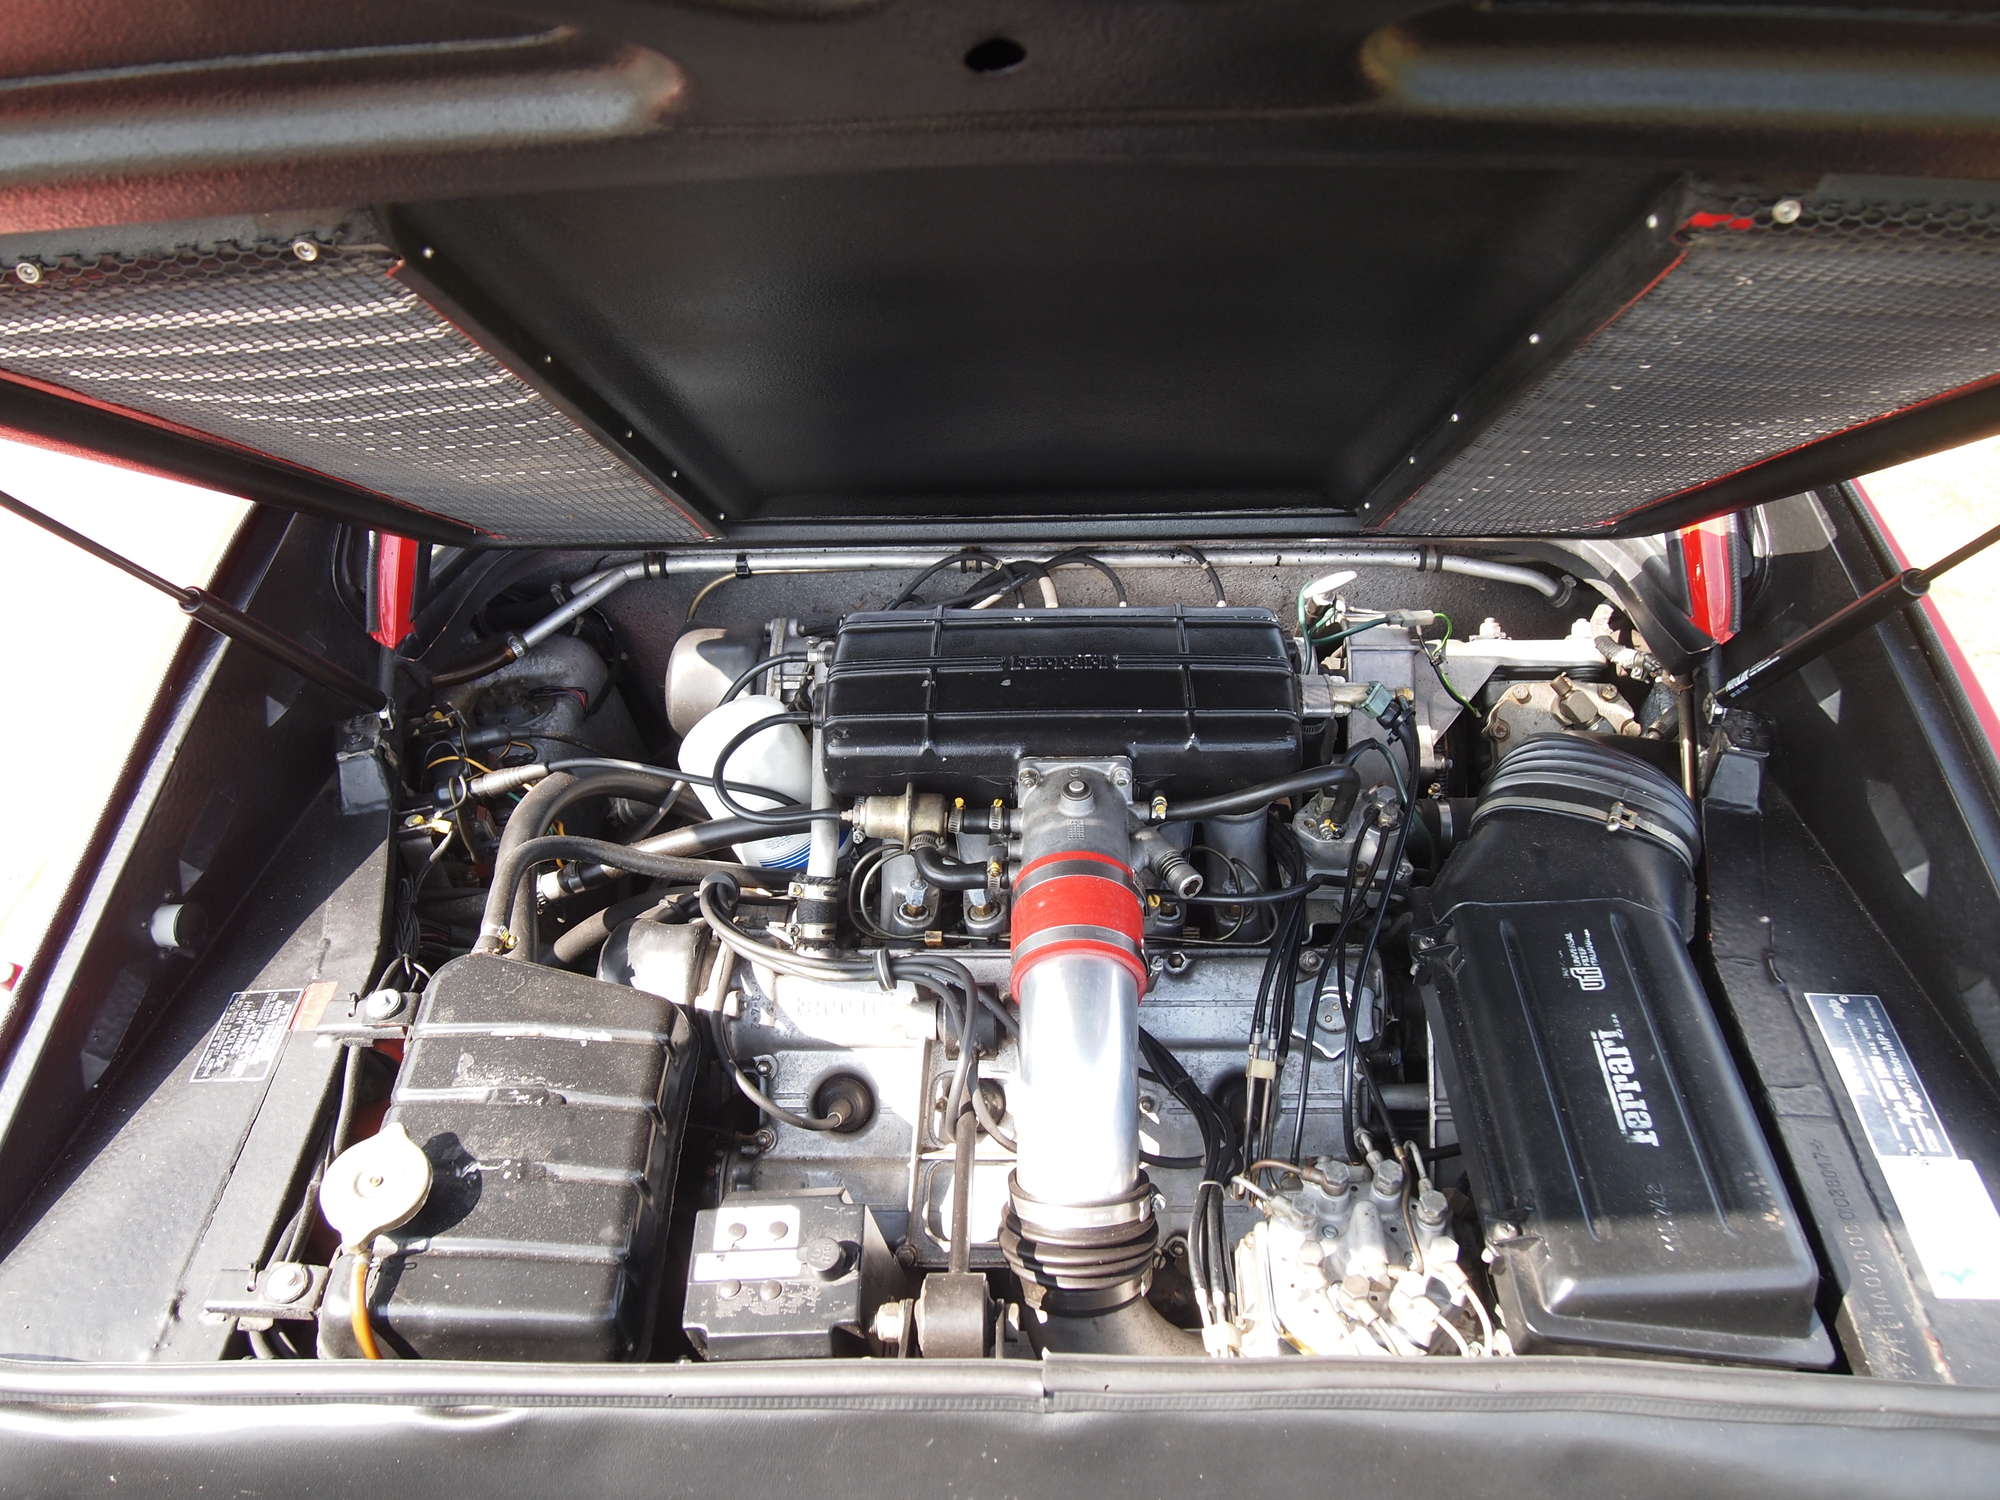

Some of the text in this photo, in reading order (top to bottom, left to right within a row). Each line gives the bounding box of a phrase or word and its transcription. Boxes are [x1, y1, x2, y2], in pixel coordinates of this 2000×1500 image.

[1564, 931, 1581, 967] UNIVERSAL
[1578, 946, 1591, 967] FILTER
[234, 1000, 253, 1023] HIGH
[1590, 1029, 1660, 1147] Ferrari
